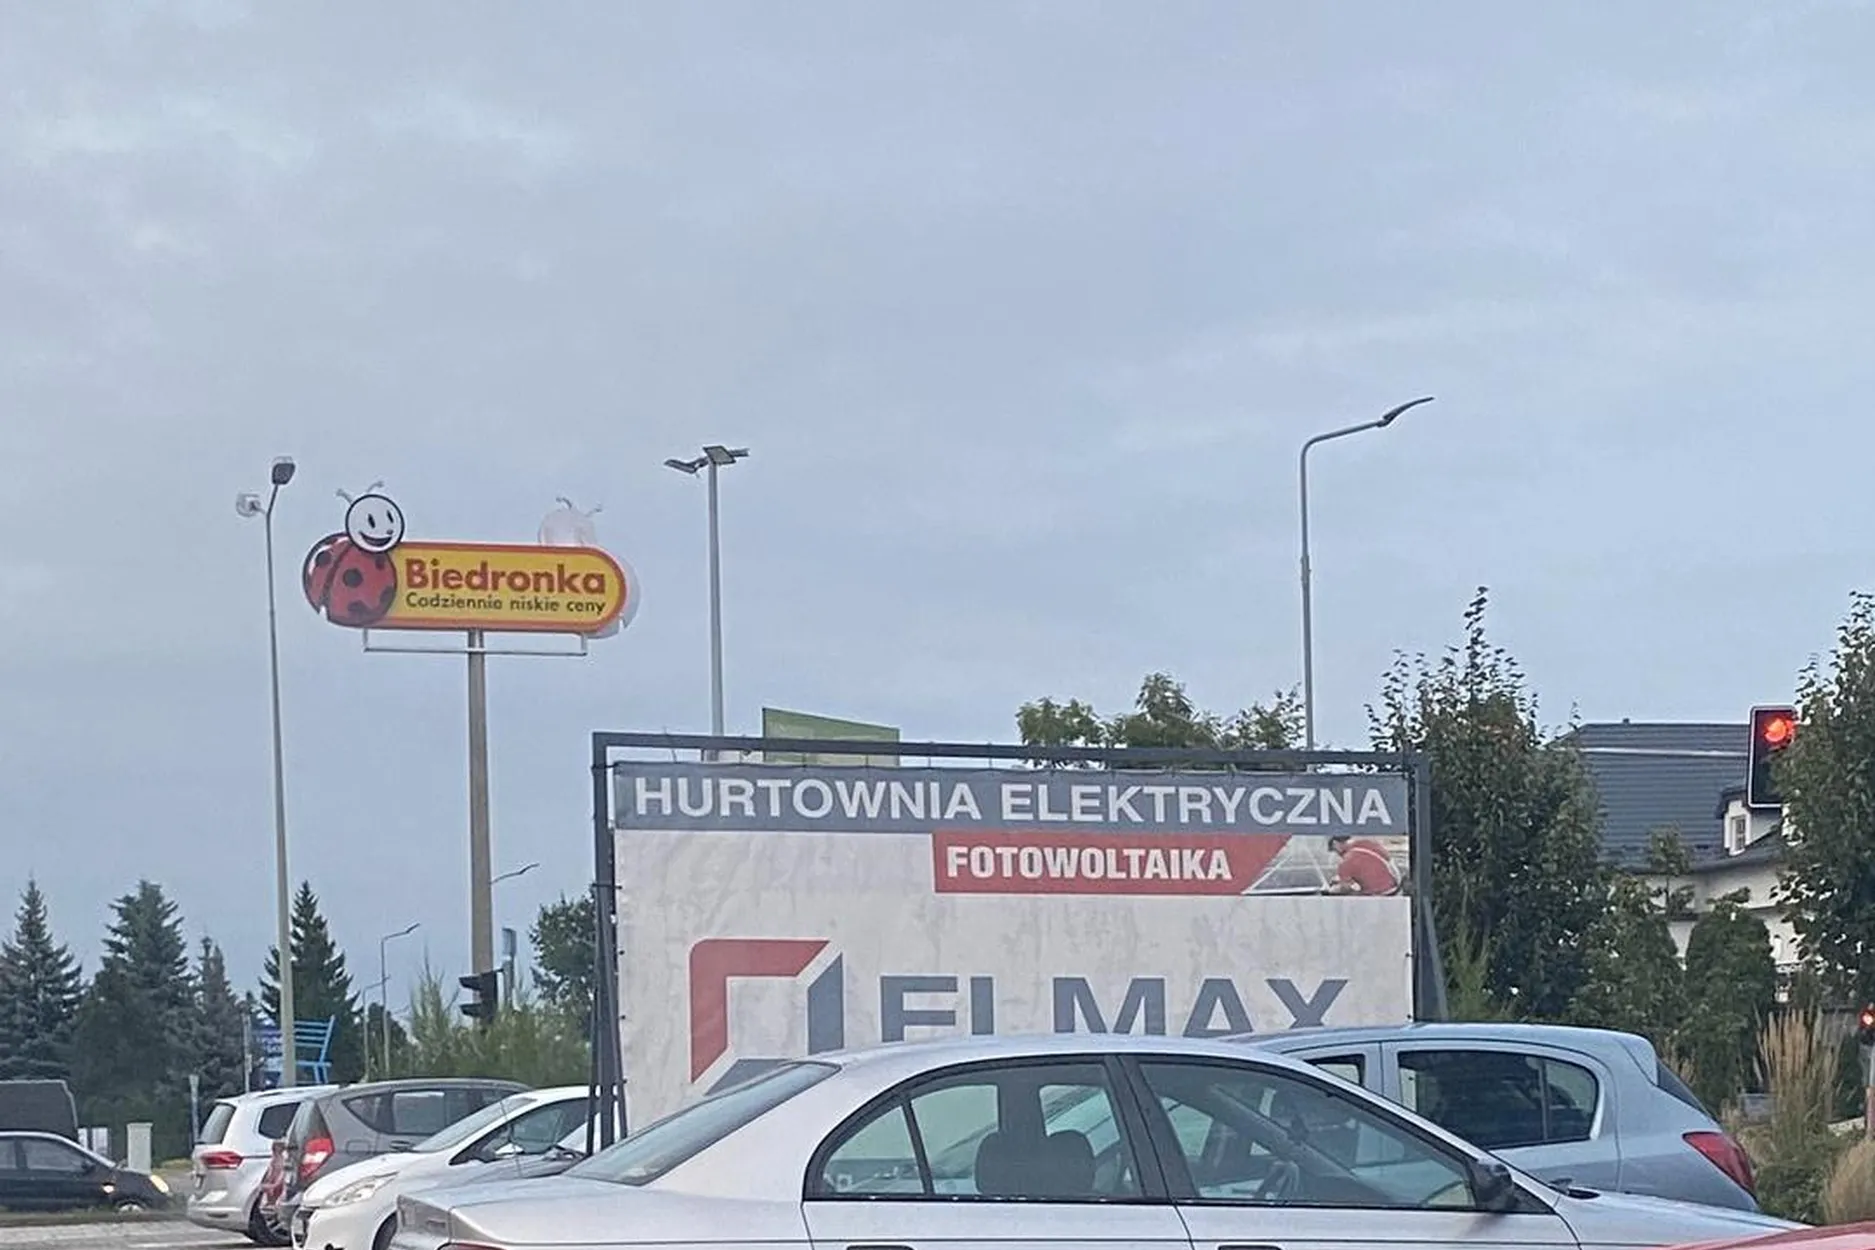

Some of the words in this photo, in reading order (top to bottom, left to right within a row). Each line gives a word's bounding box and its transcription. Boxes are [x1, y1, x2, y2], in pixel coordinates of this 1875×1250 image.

[405, 557, 606, 594] Biedronka
[405, 591, 503, 609] Codziennie
[509, 596, 560, 612] niskie
[566, 600, 607, 616] ceny
[634, 776, 983, 820] HURTOWNIA
[1000, 783, 1393, 826] ELEKTRYCZNA
[946, 845, 1233, 881] FOTOWOLTAIKA
